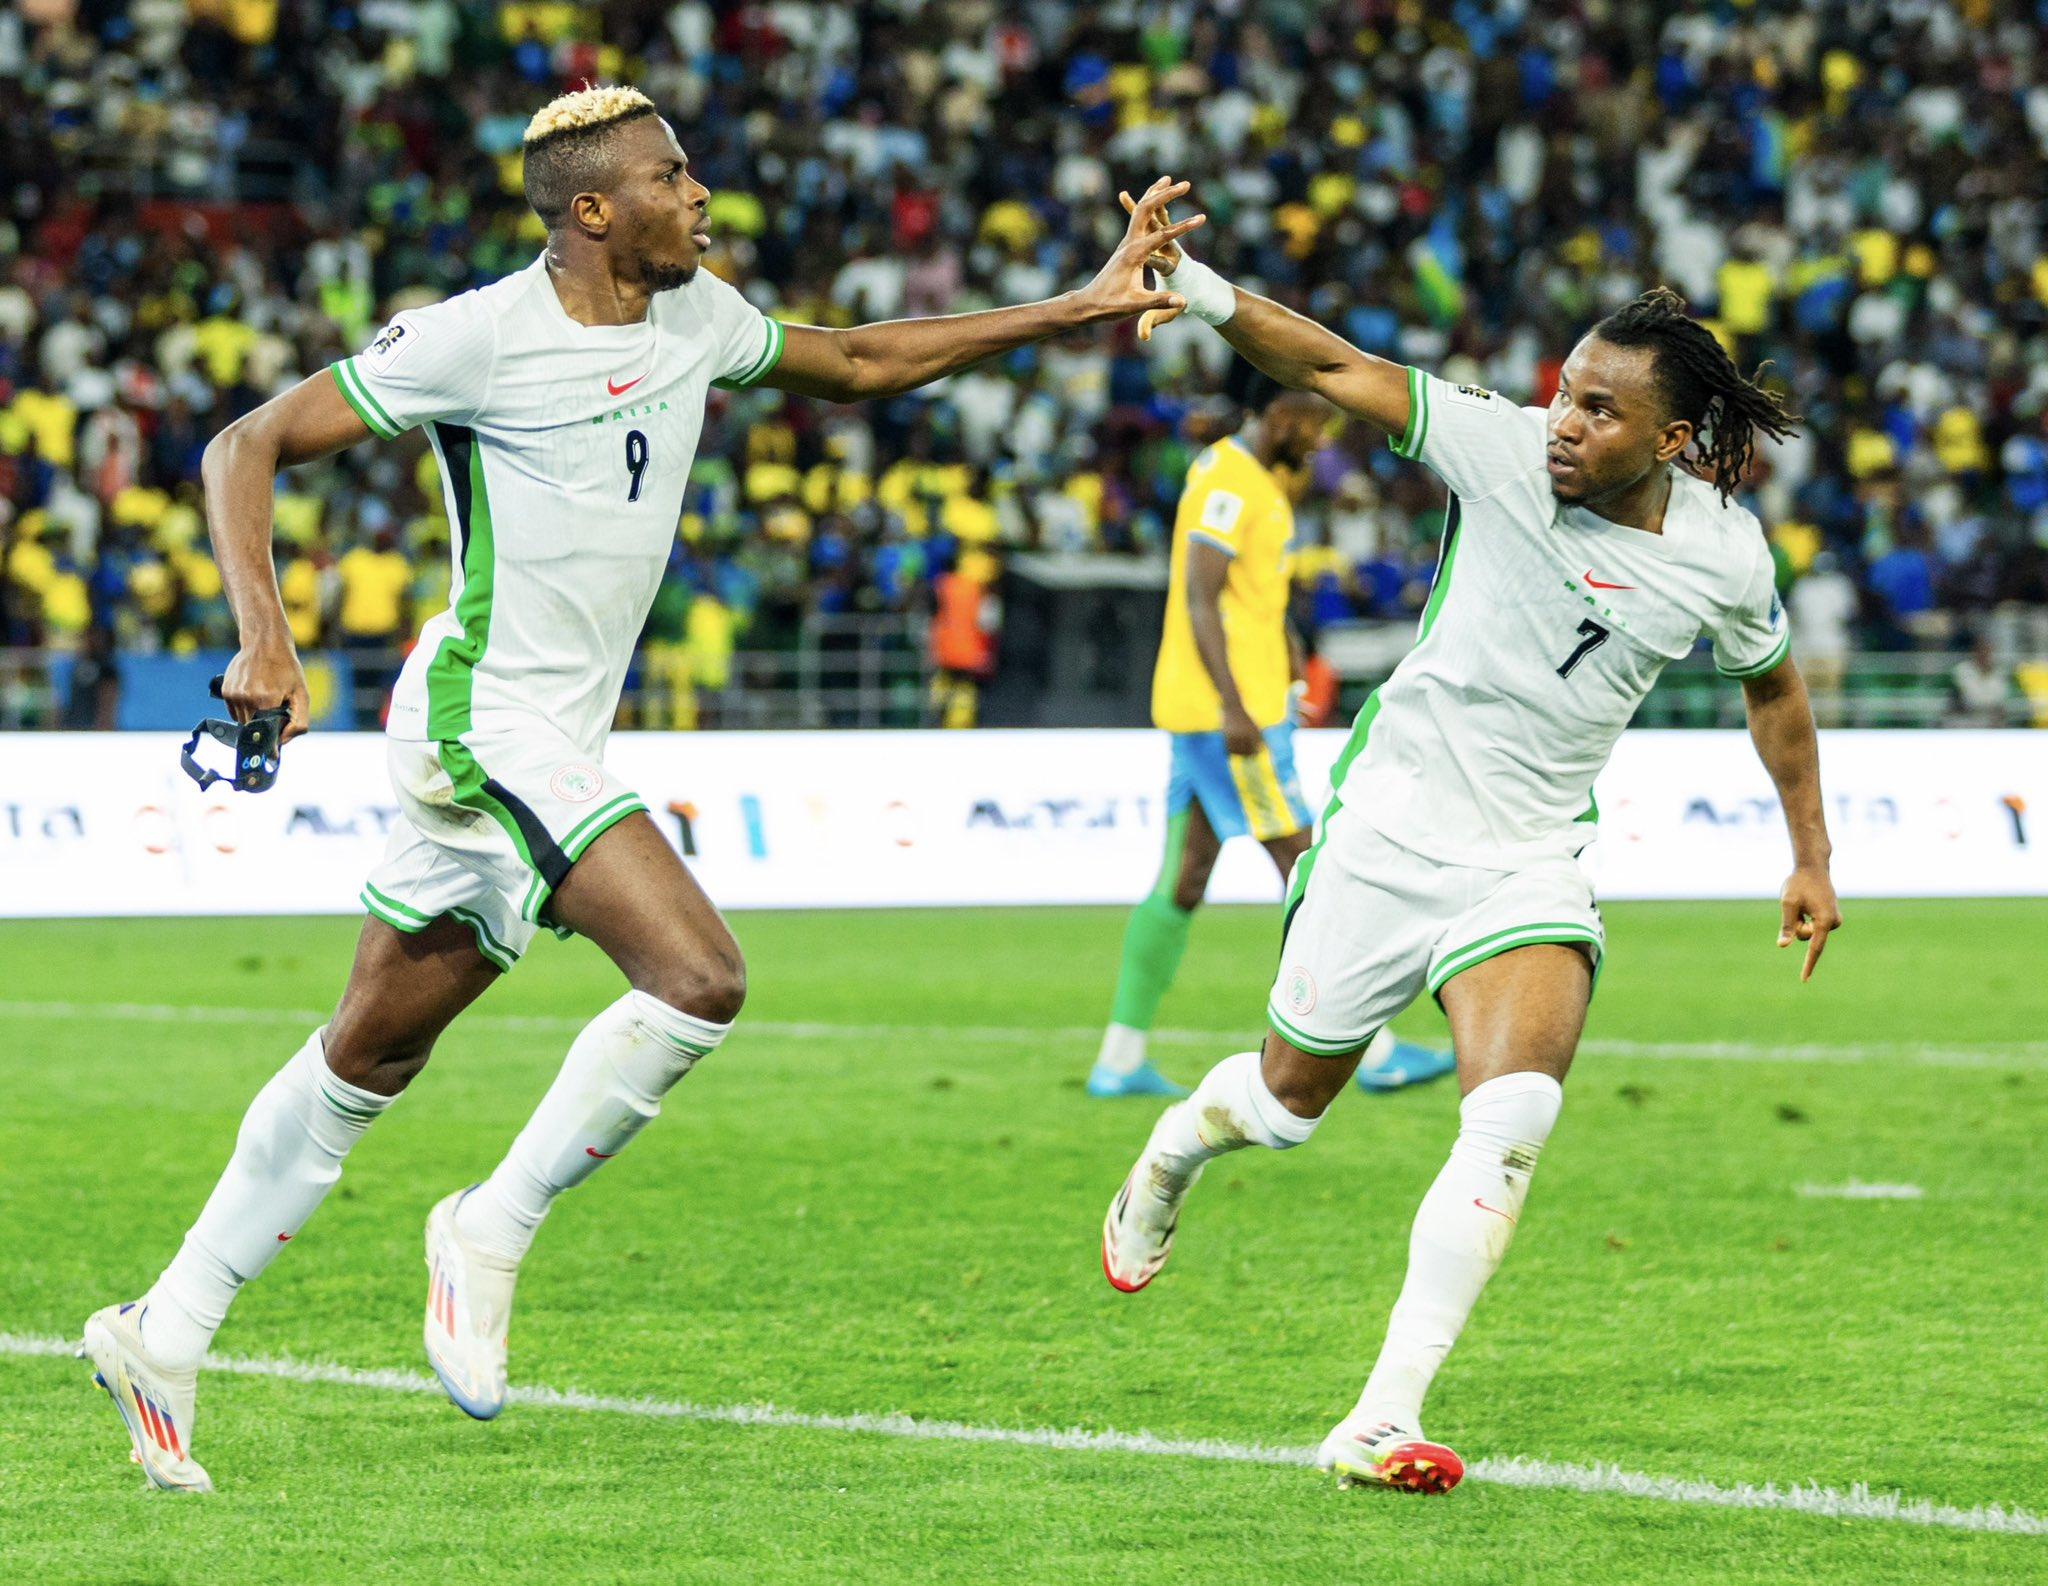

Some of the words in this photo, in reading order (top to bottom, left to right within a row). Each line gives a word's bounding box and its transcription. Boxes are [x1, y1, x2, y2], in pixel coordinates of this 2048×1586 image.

[592, 401, 669, 424] NAIJA
[625, 429, 650, 503] 9
[1555, 617, 1611, 680] 7
